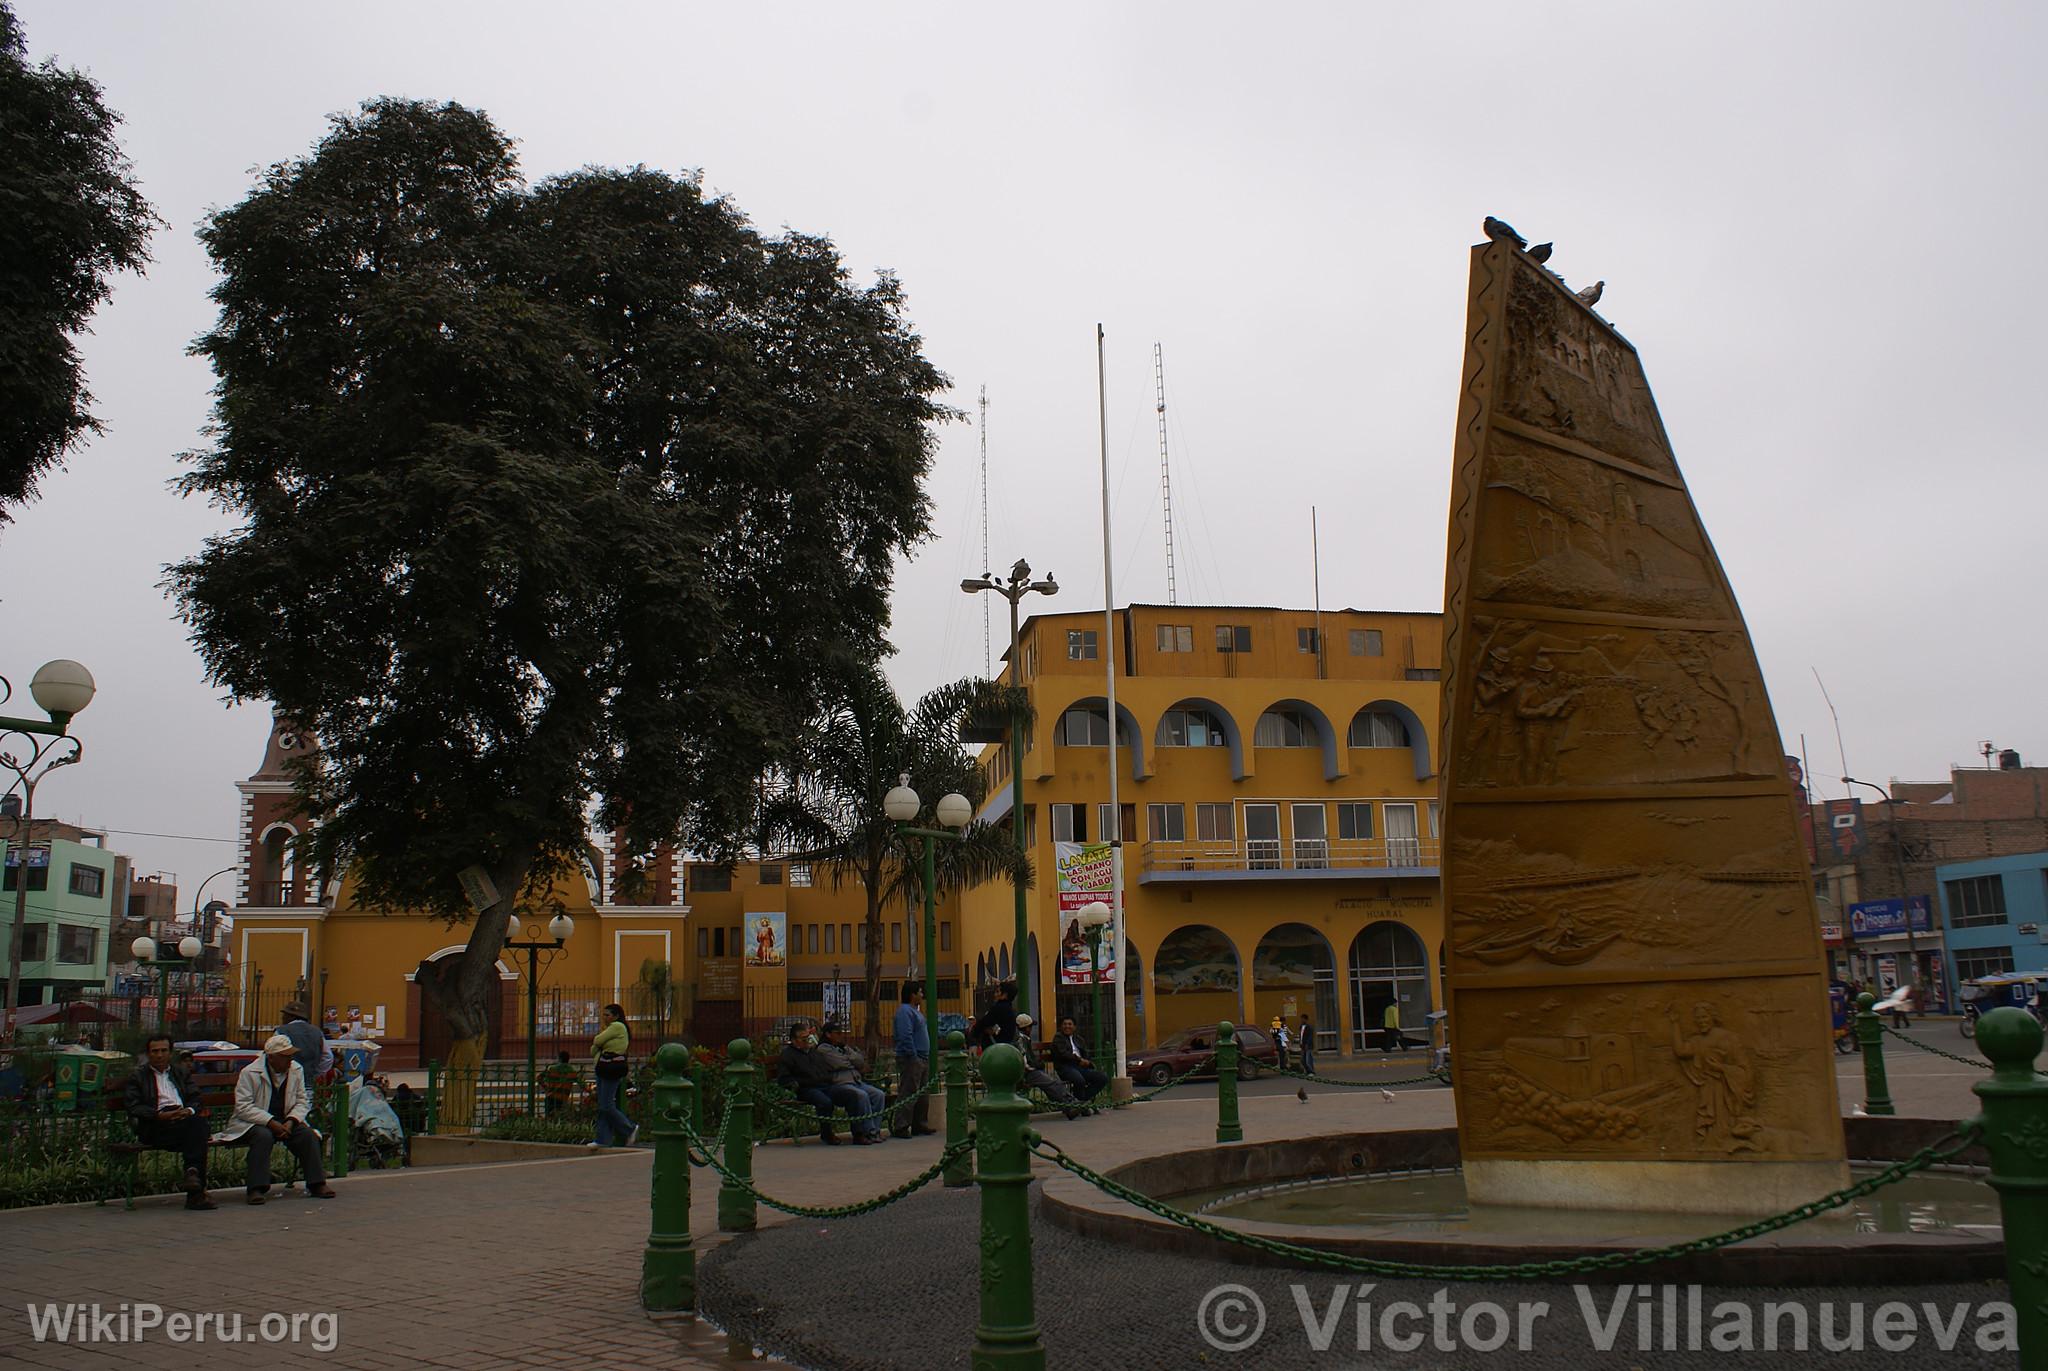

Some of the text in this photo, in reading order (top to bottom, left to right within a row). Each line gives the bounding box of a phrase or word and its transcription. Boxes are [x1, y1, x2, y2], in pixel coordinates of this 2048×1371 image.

[1060, 848, 1112, 870] LAVATE
[1066, 860, 1112, 877] LAS MANO
[1070, 868, 1112, 885] CON AGU
